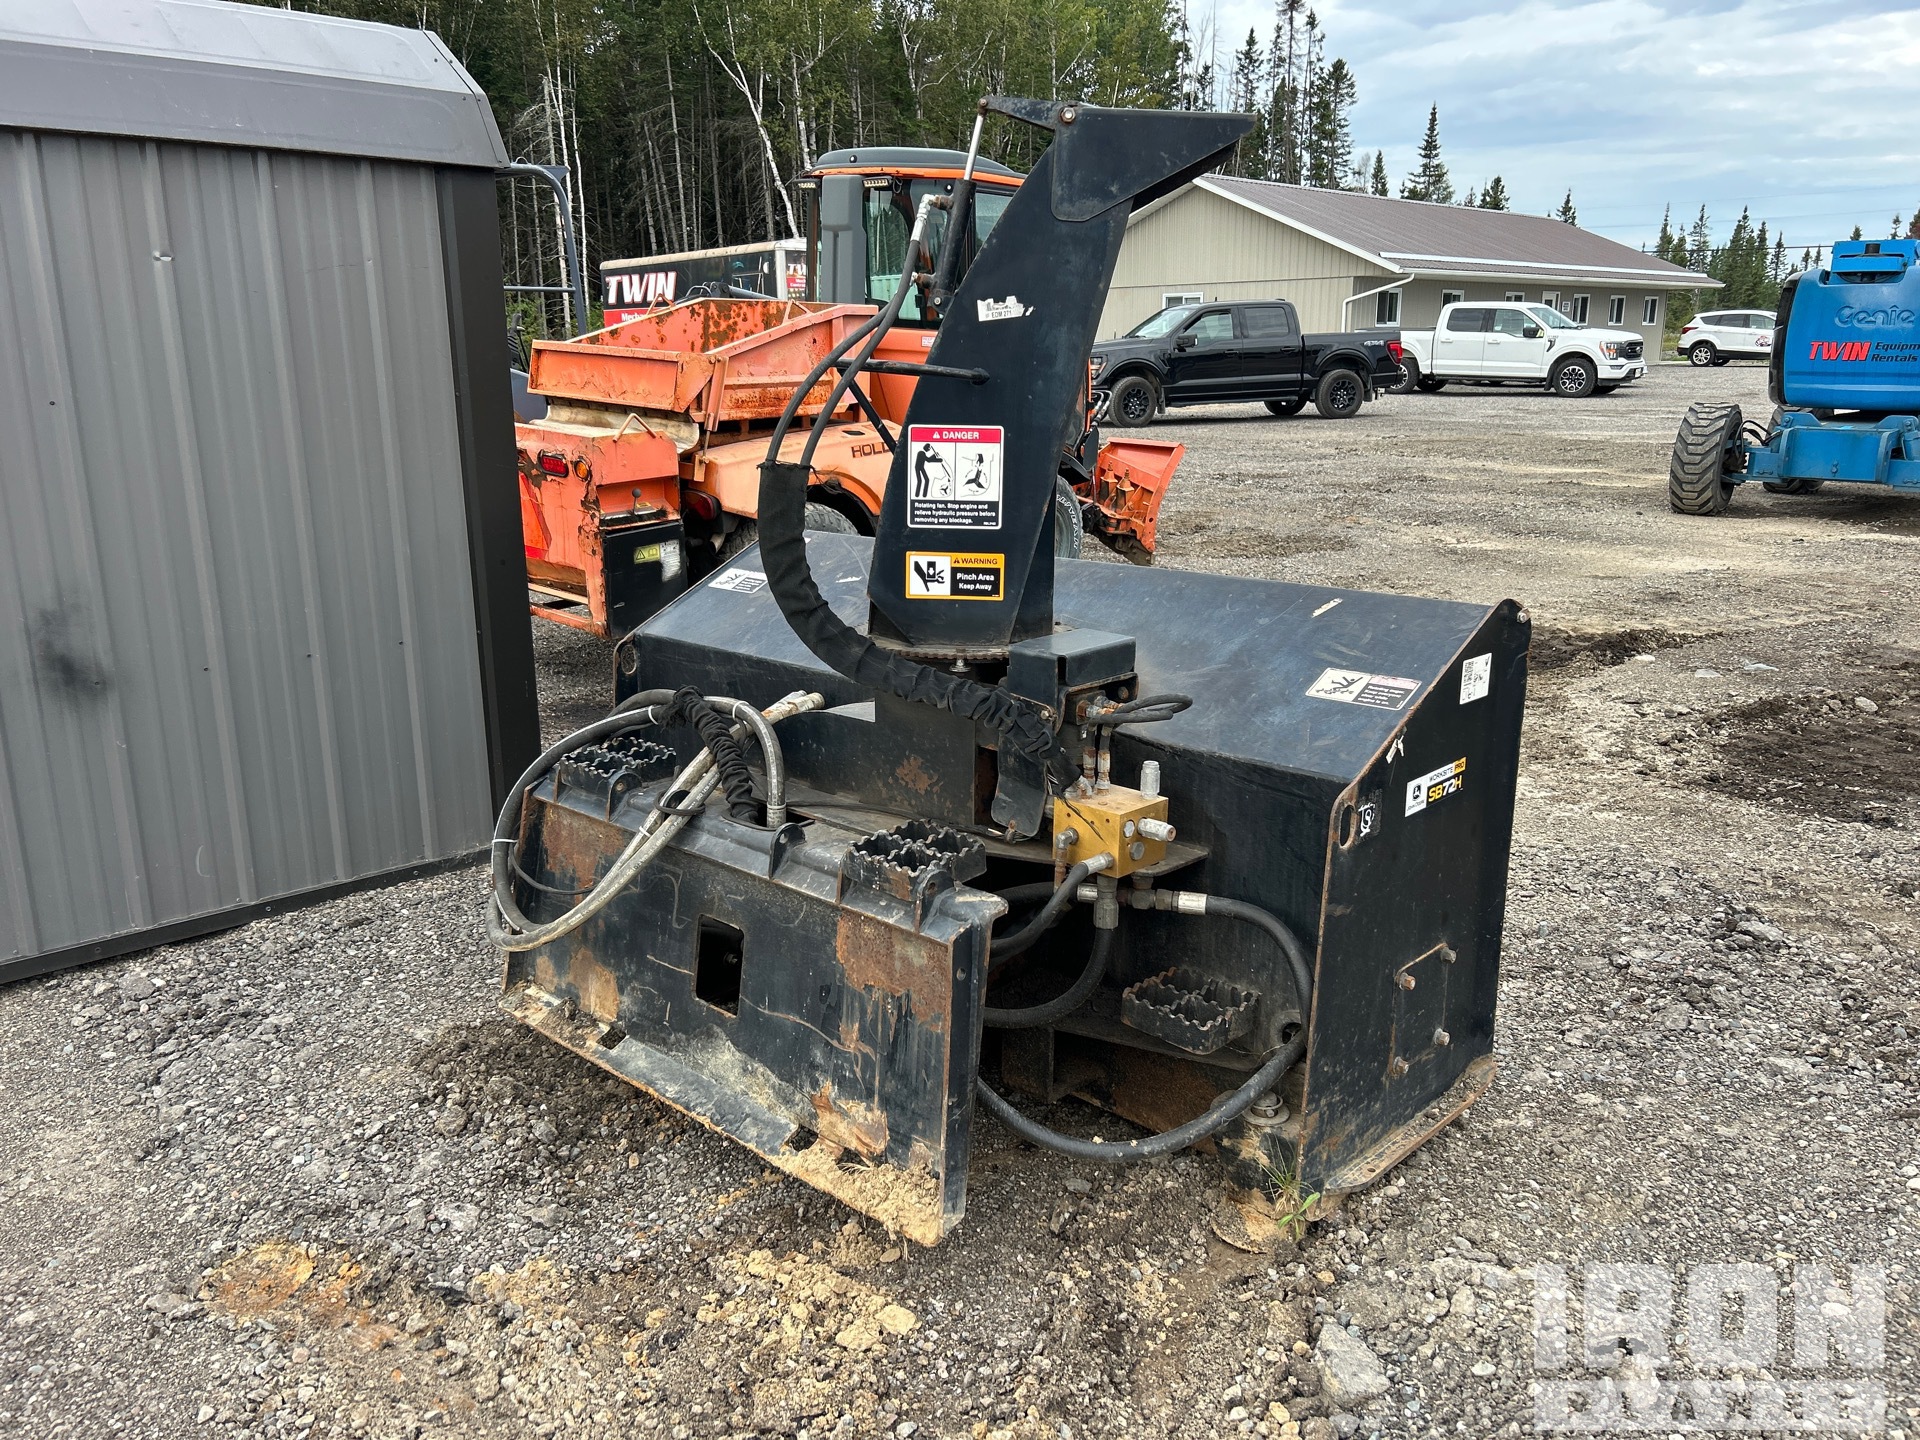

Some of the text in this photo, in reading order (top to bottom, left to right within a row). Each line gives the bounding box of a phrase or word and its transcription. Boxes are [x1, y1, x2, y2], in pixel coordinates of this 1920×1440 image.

[605, 271, 677, 305] TWIN
[1834, 304, 1915, 328] Genie
[1809, 342, 1872, 361] TWIN
[1871, 353, 1918, 362] Rentals
[942, 431, 980, 440] DANGER
[949, 517, 973, 525] blockage.
[957, 573, 995, 581] Pinch Area
[959, 583, 992, 591] Keep Away
[1455, 761, 1465, 772] PRO
[1428, 774, 1463, 802] SB72H
